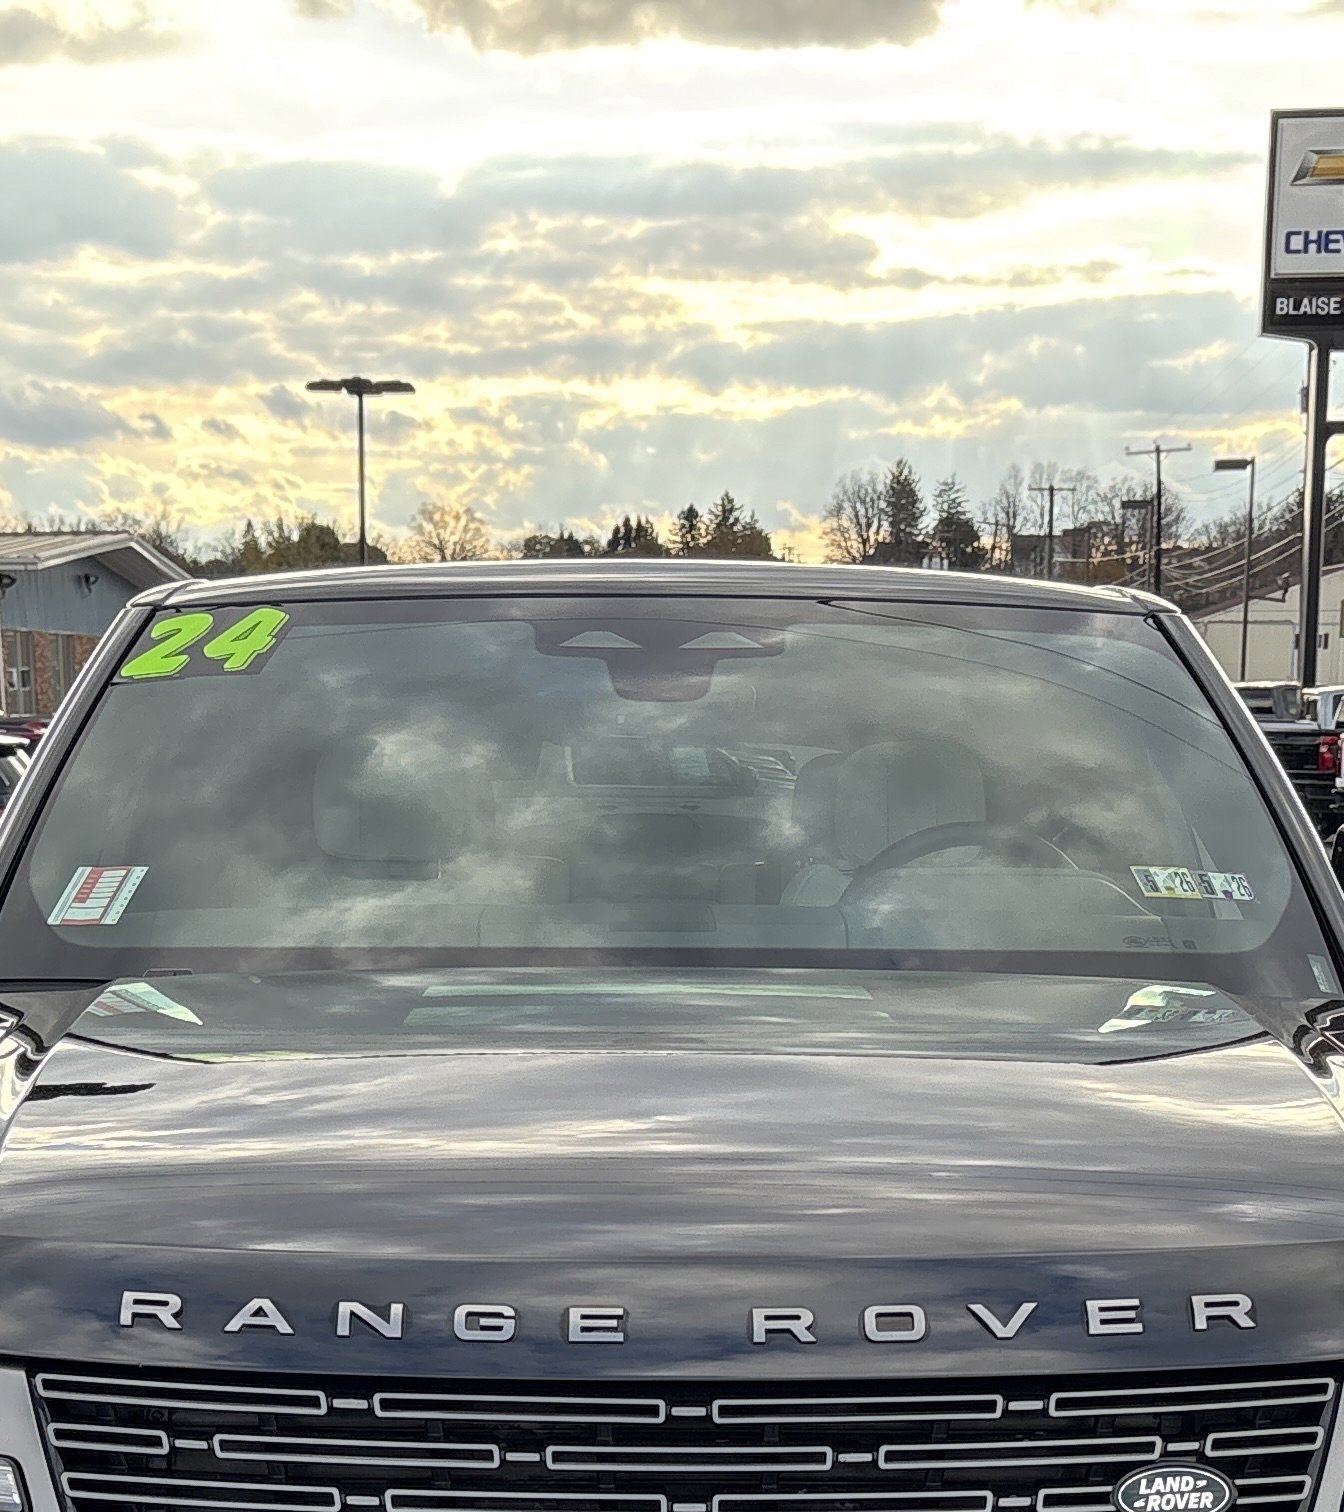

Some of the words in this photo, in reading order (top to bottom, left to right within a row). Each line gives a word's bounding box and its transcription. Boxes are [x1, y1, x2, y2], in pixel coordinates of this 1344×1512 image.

[1275, 297, 1343, 316] BLAISE
[120, 607, 290, 680] 24
[1173, 871, 1196, 893] 26
[1230, 875, 1253, 898] 26
[118, 1289, 627, 1343] RANGE
[751, 1292, 1257, 1344] ROVER
[1138, 1475, 1195, 1495] LAND
[1145, 1491, 1214, 1512] ROVER
